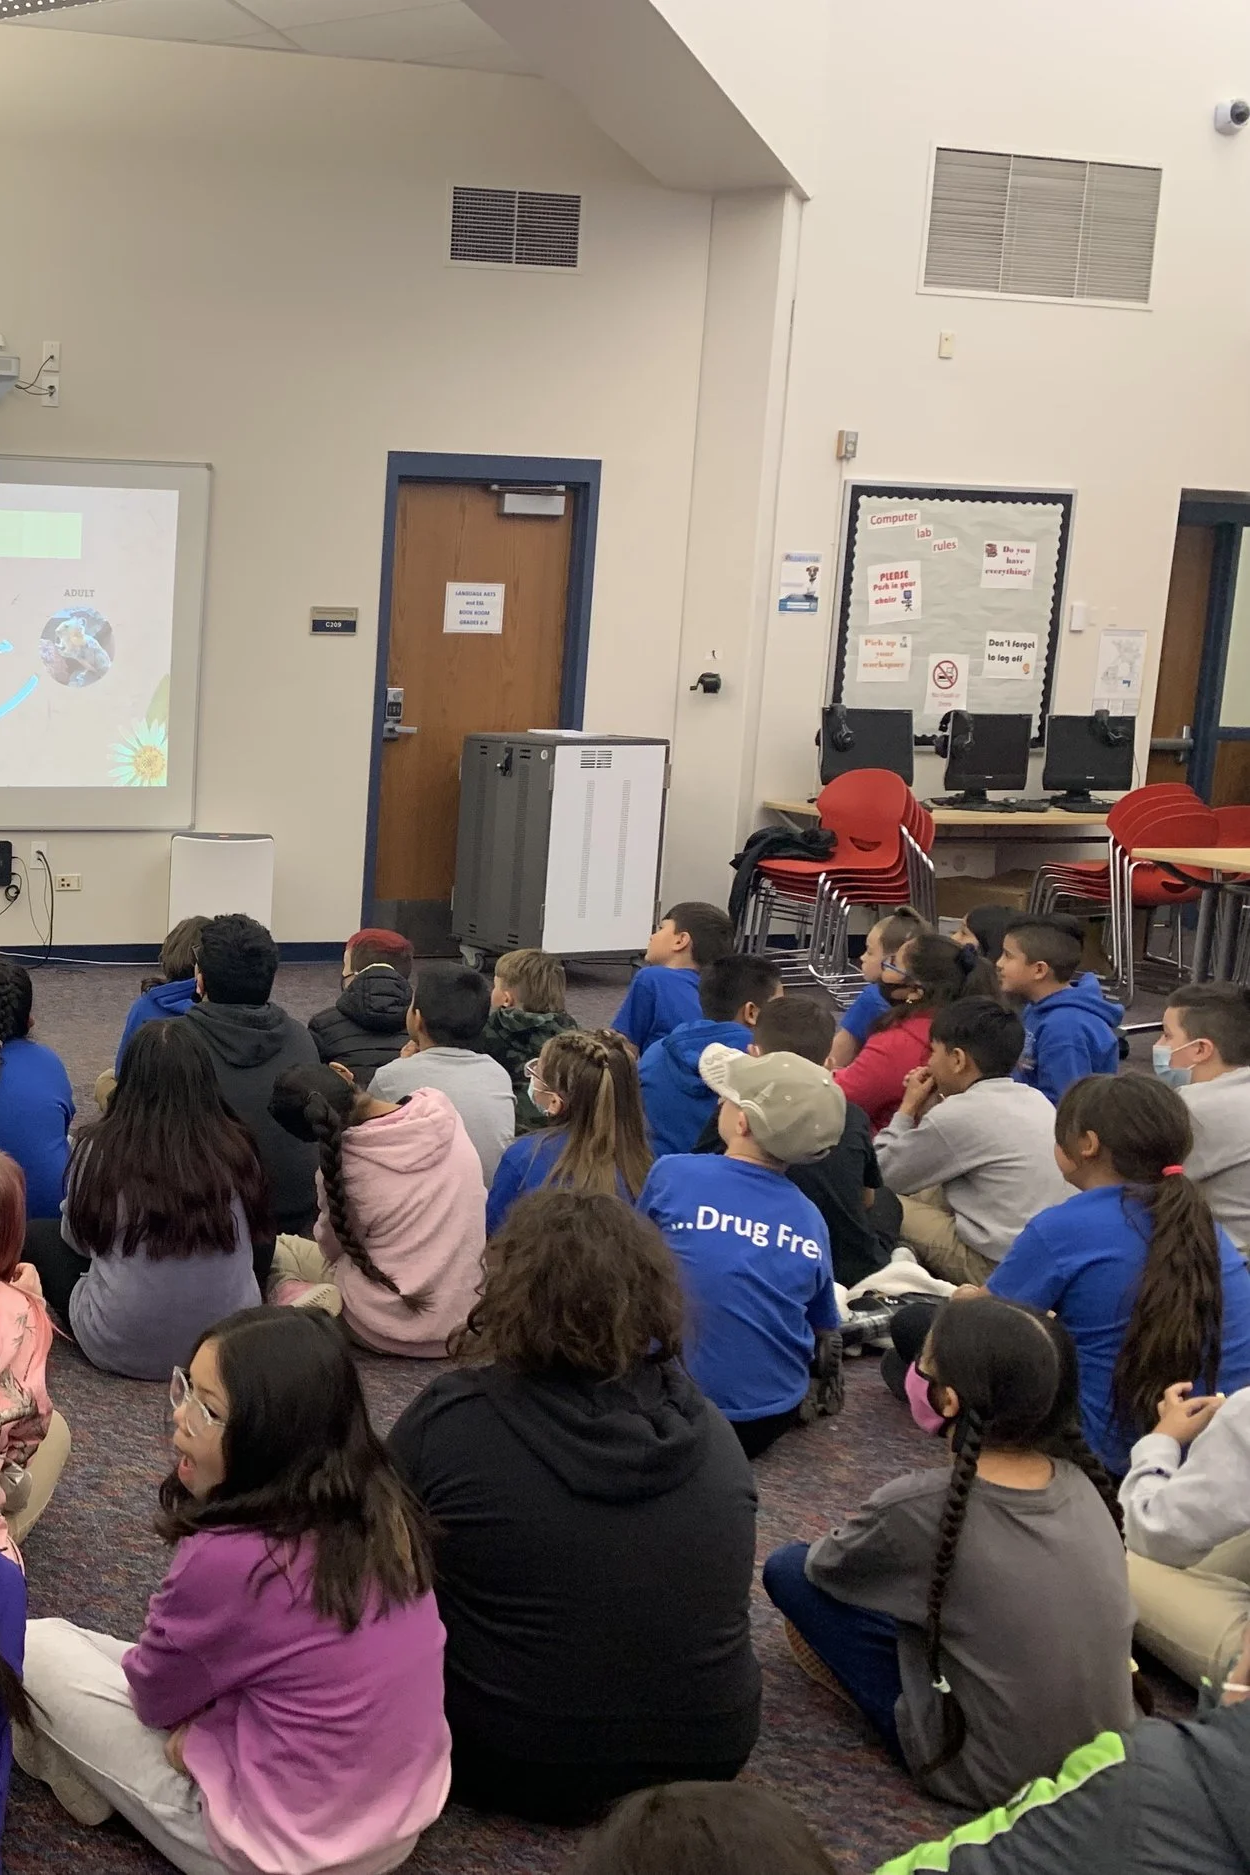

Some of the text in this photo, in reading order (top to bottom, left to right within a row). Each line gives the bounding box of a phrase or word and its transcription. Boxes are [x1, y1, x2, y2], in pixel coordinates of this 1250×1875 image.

[870, 512, 918, 525] Computer
[916, 528, 932, 539] lab
[933, 540, 957, 552] rules
[1002, 545, 1031, 556] Do you
[1006, 556, 1025, 565] have
[879, 570, 909, 582] PLEASE
[984, 567, 1032, 577] everything?
[873, 580, 916, 592] Push in your
[63, 589, 96, 598] ADULT
[864, 639, 883, 647] Pick
[988, 638, 1035, 650] Don't forget
[987, 653, 1023, 664] to log off
